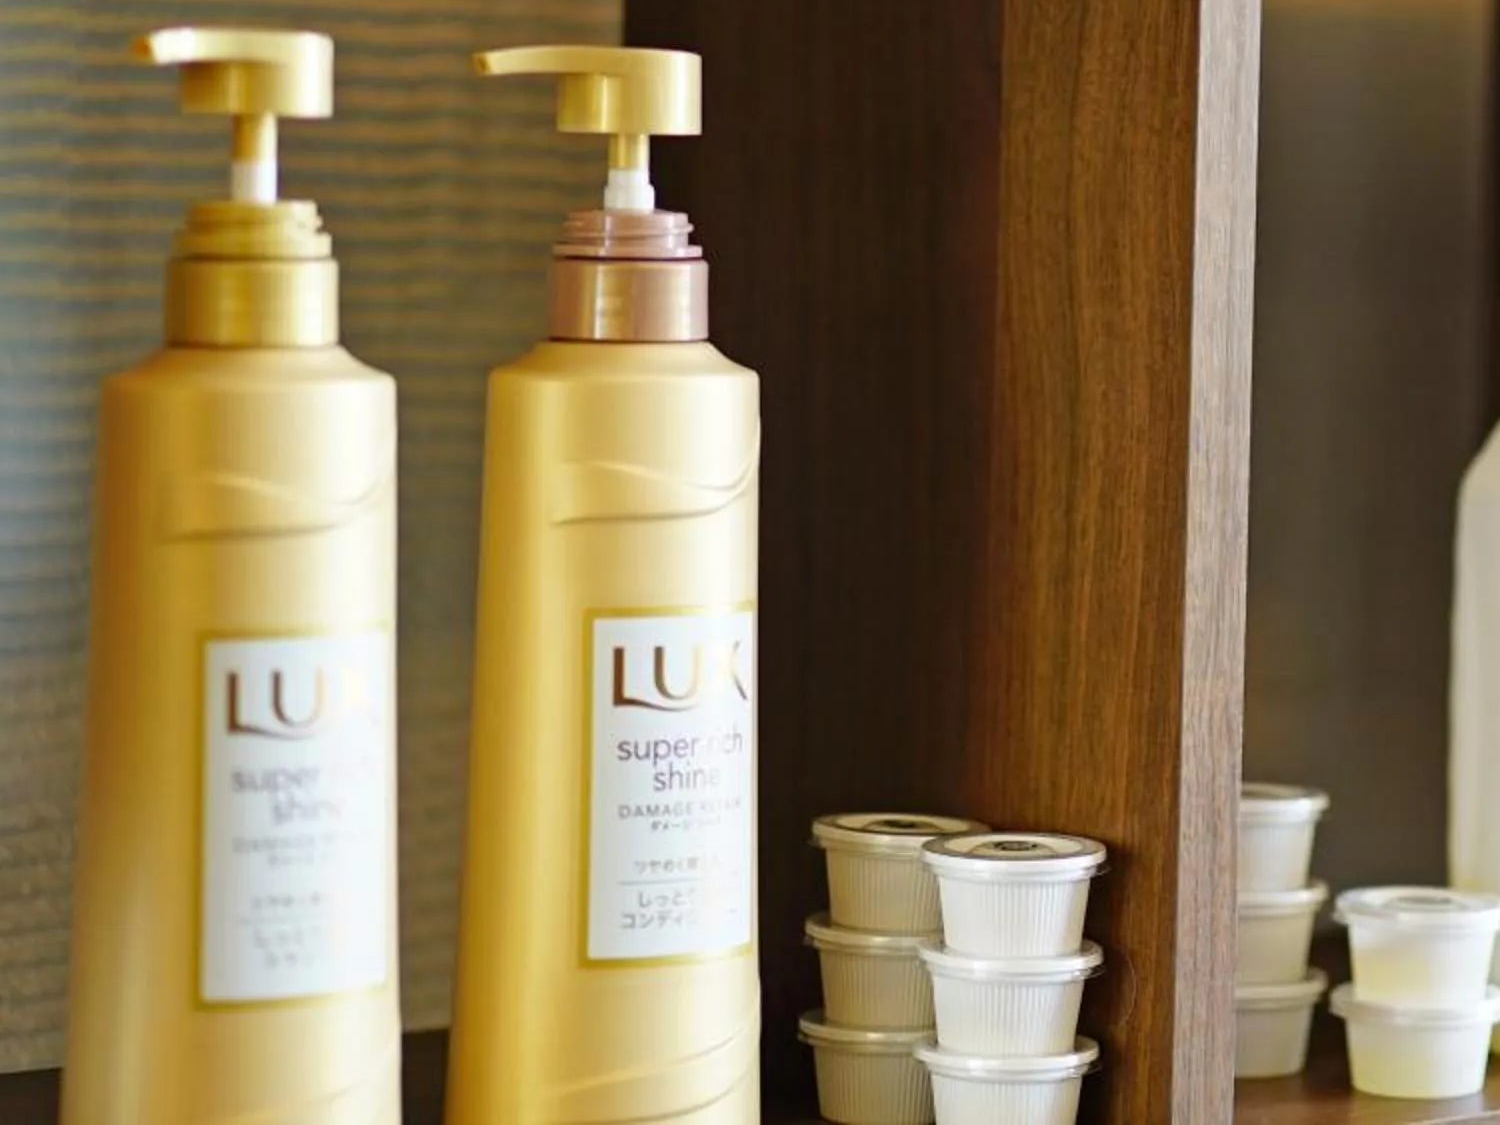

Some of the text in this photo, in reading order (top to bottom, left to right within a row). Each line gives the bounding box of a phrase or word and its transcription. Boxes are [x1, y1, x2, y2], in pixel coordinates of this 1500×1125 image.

[226, 666, 326, 741] LU
[616, 736, 702, 768] super
[653, 761, 721, 793] shine
[618, 801, 693, 820] DAMAGE
